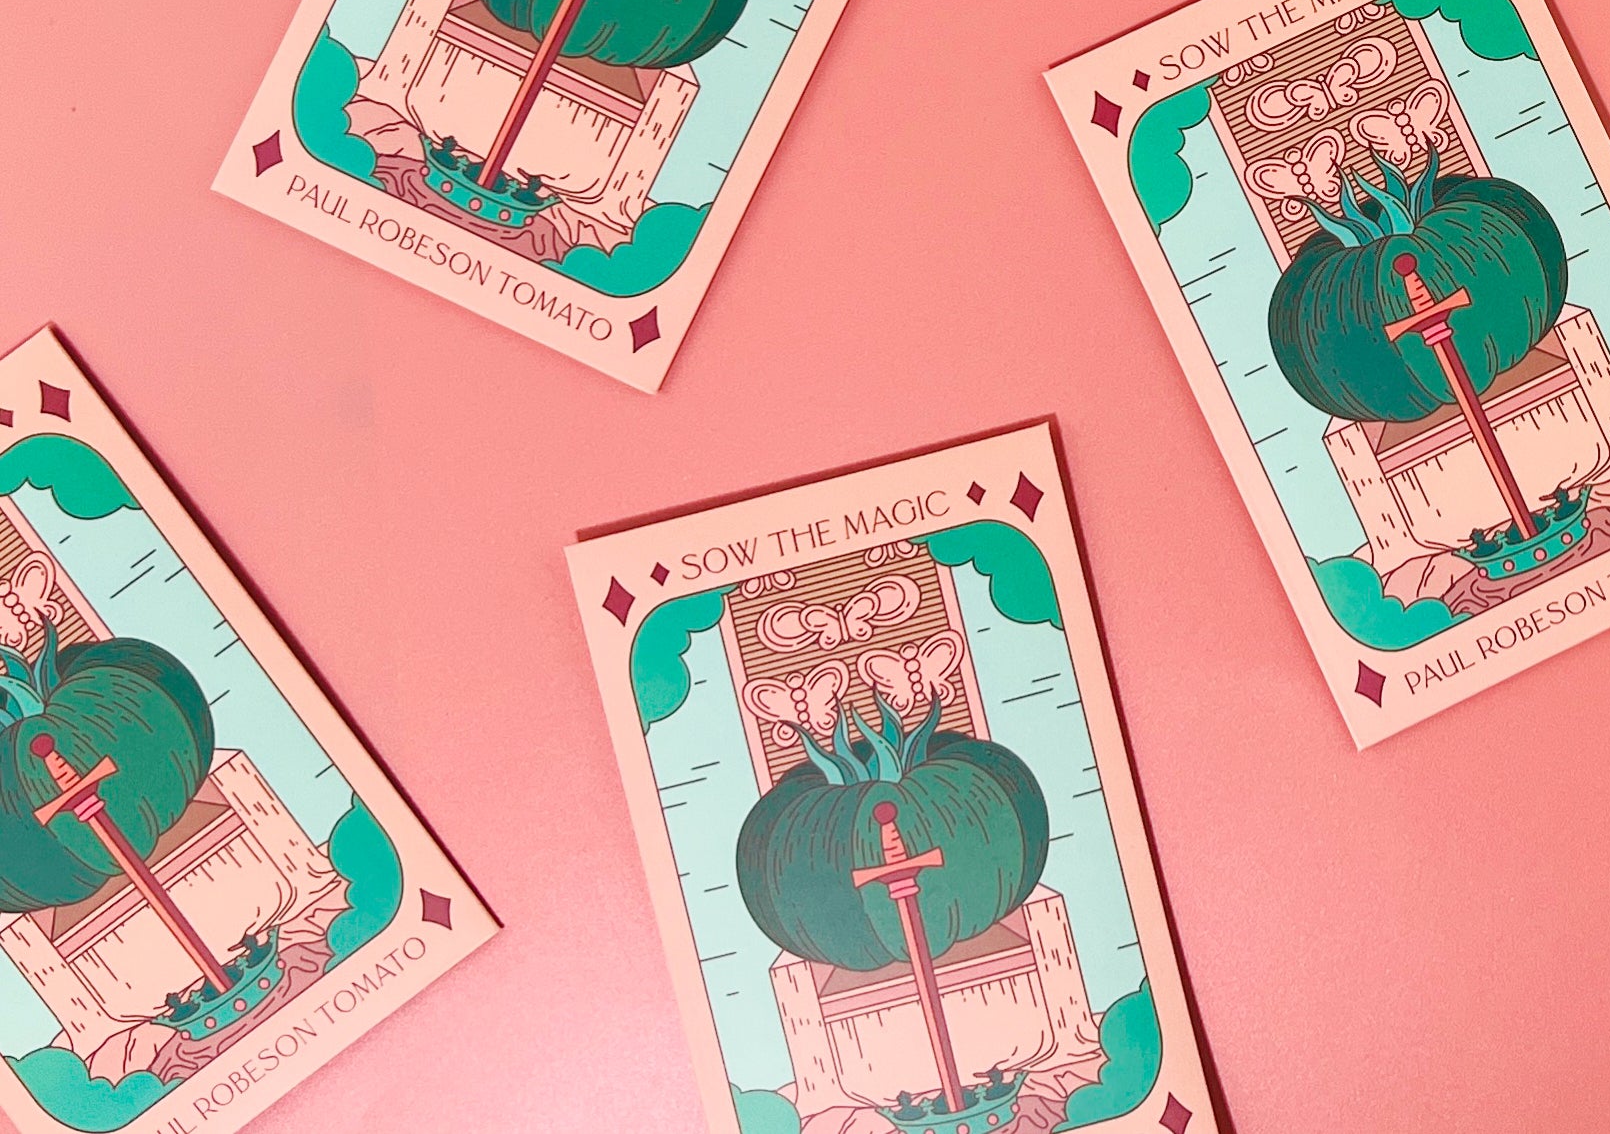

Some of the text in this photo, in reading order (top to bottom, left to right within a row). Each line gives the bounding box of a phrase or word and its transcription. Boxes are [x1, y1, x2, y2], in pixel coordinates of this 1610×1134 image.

[1158, 27, 1230, 81] SOW
[286, 174, 613, 341] PAUL ROBESON TOMATO
[681, 490, 950, 581] SOW THE MAGIC
[1404, 649, 1476, 695] PAUL
[1475, 580, 1607, 660] ROBESON
[192, 1017, 318, 1121] ROBESON
[313, 937, 426, 1024] TOMATO
